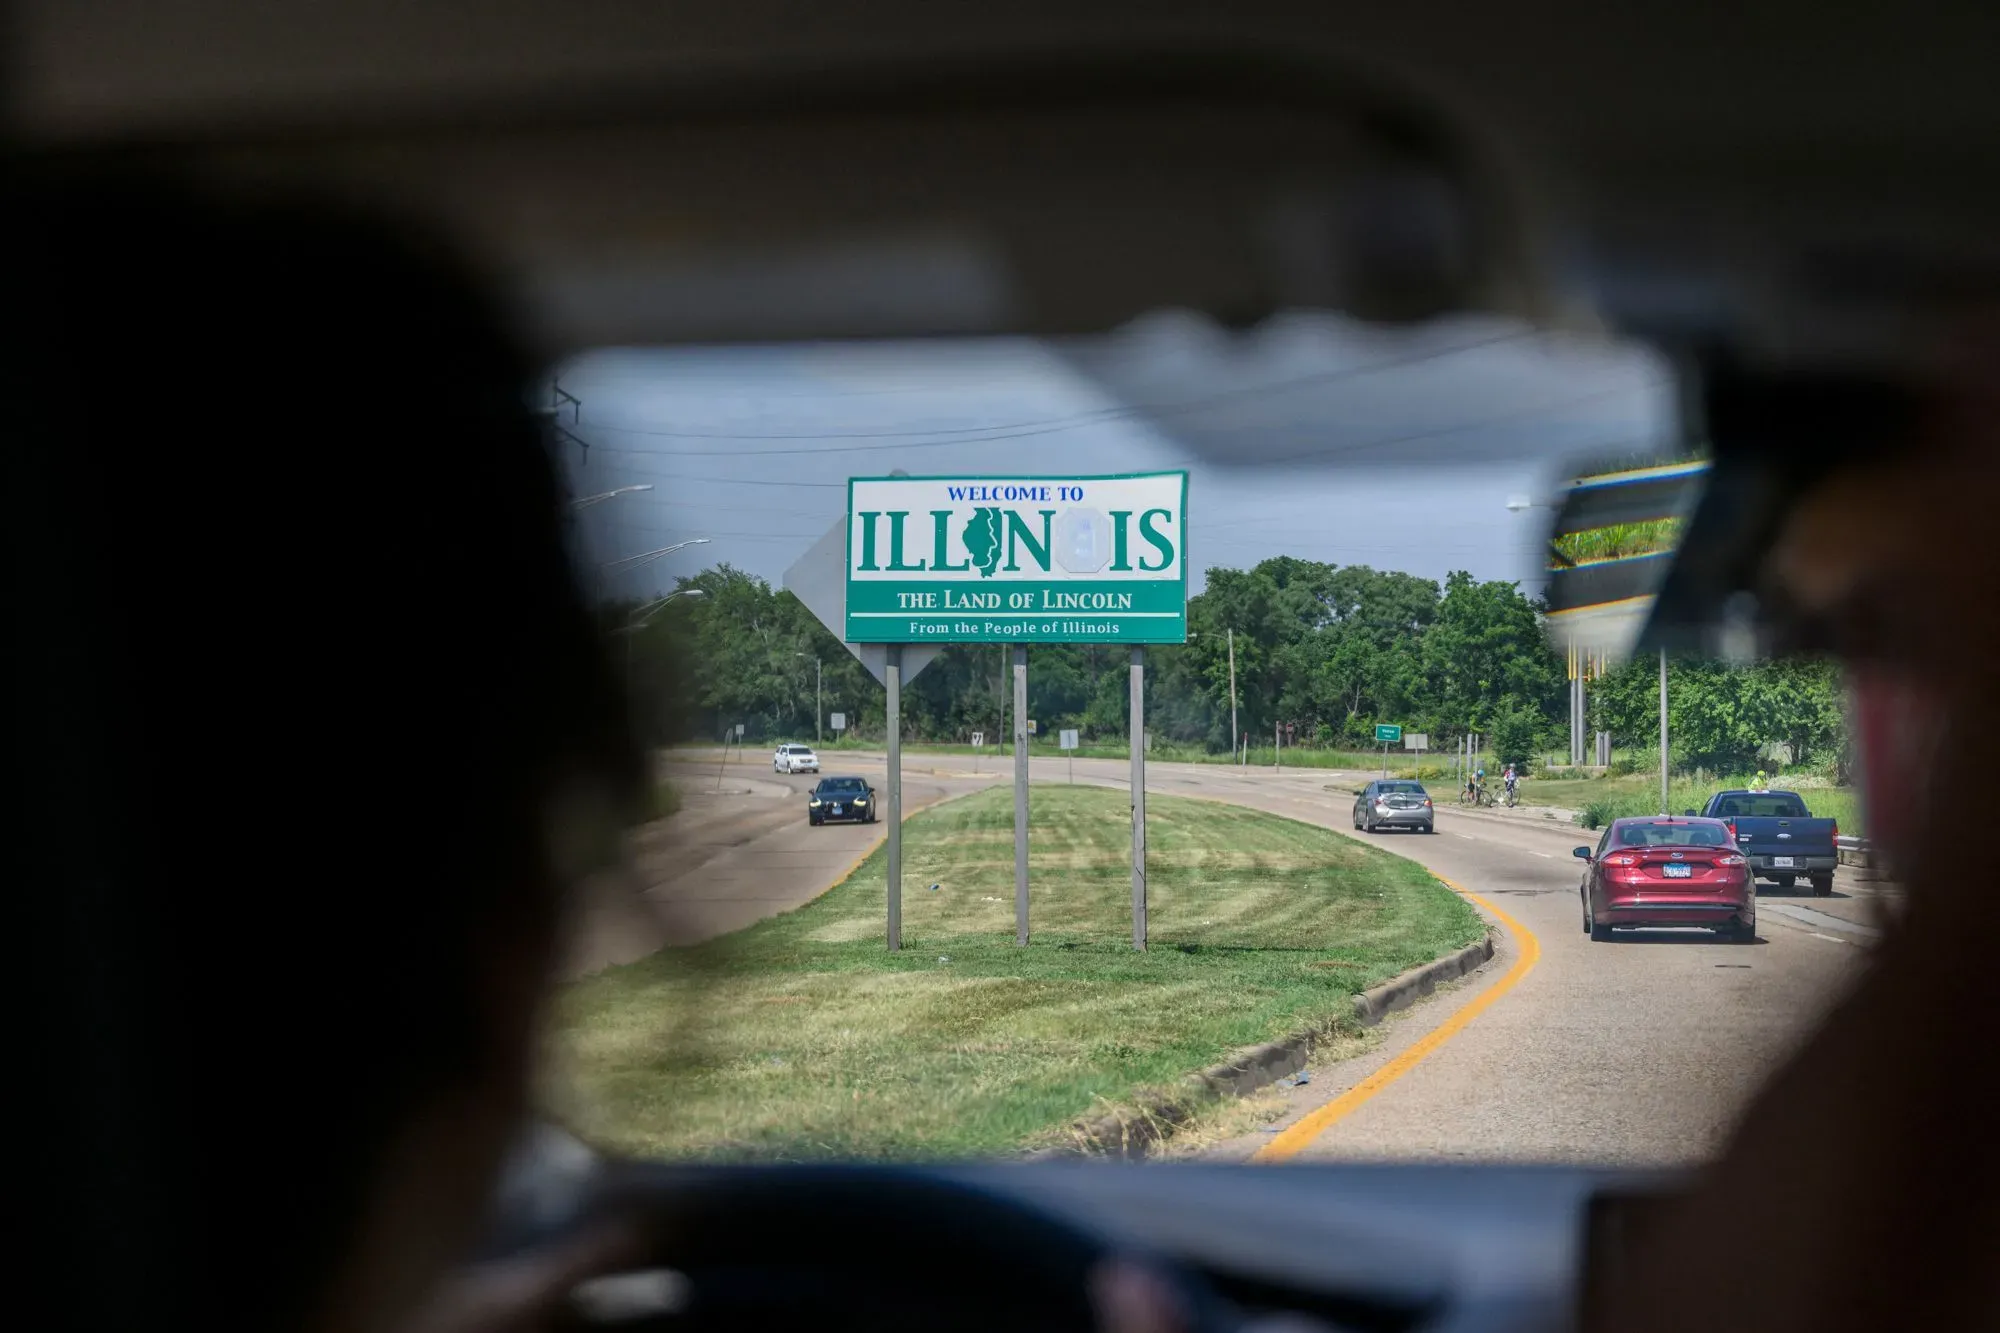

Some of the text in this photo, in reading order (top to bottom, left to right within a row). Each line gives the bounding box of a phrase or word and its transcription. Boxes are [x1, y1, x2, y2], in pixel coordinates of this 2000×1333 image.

[948, 486, 1084, 501] WELCOME TO
[897, 592, 937, 608] THE
[1009, 592, 1034, 608] OF
[1042, 589, 1132, 609] LINCOLN
[910, 621, 1120, 635] From the People of Illinois
